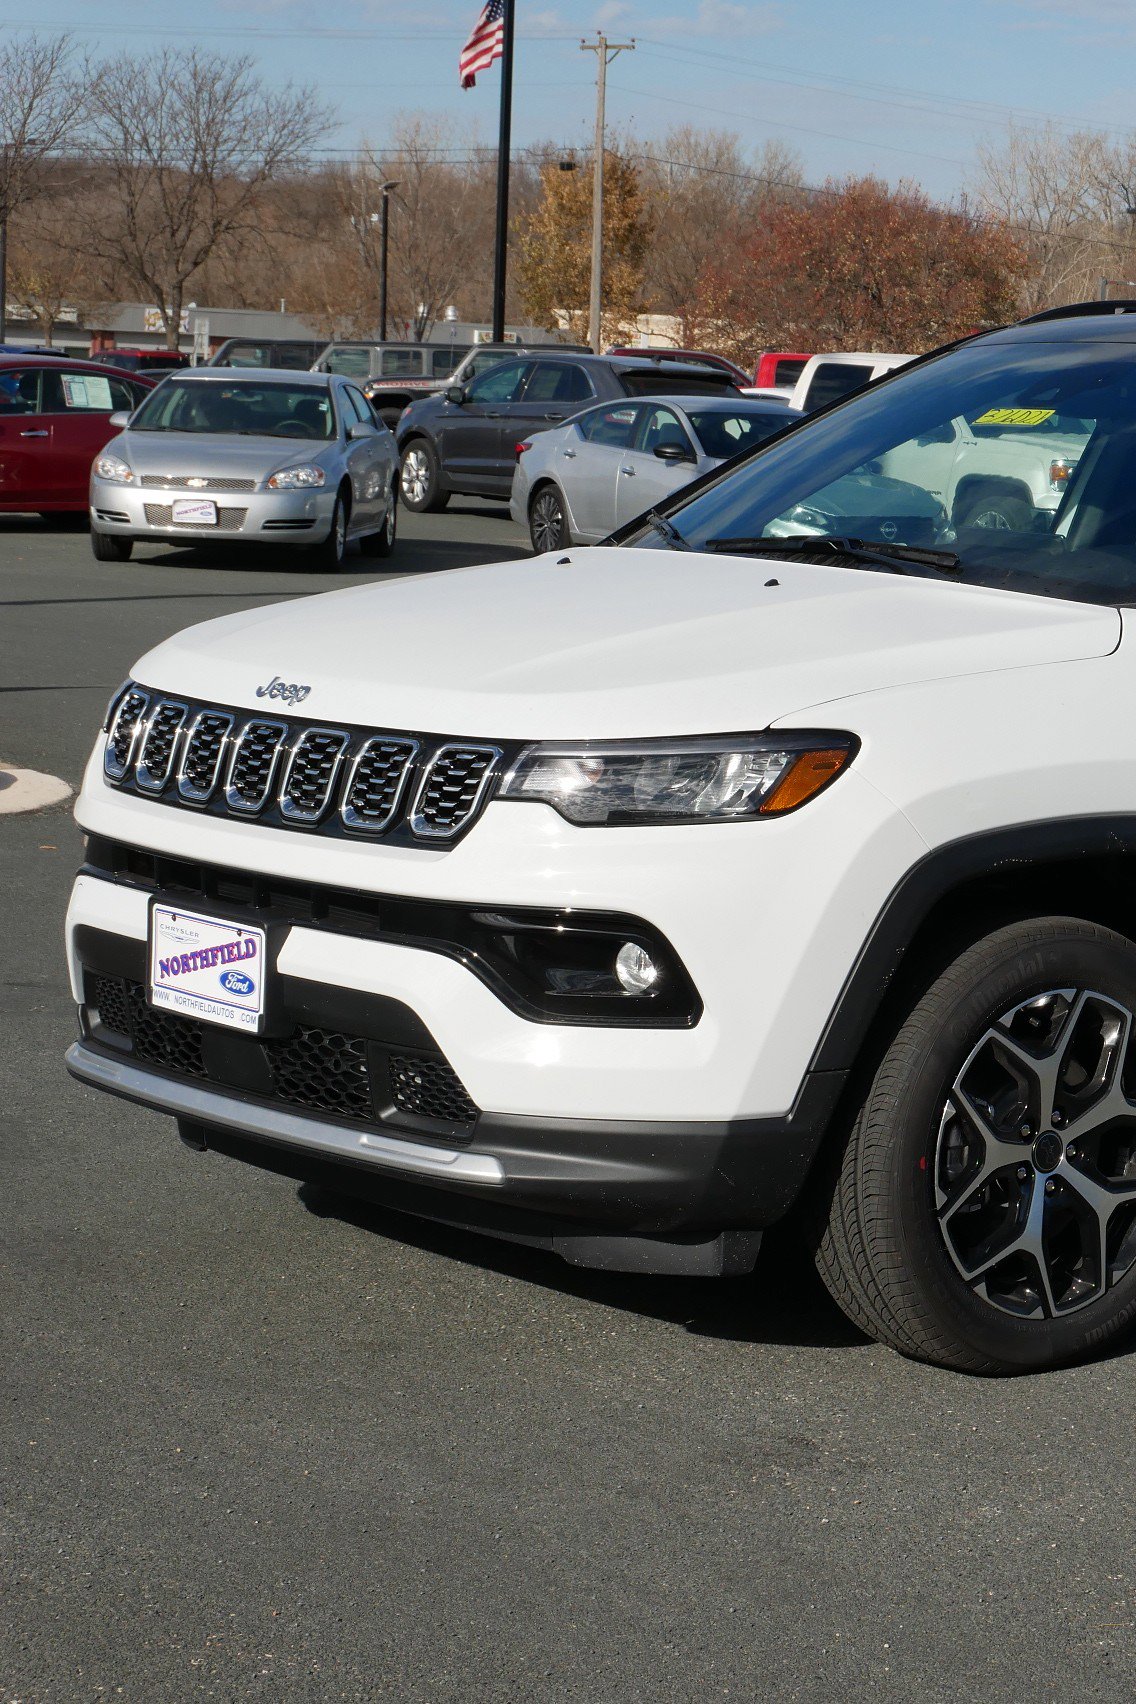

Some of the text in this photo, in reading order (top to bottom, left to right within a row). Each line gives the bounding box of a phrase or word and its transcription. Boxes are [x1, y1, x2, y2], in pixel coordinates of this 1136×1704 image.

[256, 676, 311, 706] Jeep
[159, 923, 200, 938] CHRYSLER
[158, 937, 257, 979] NORTHFIELD
[225, 972, 249, 993] Ford
